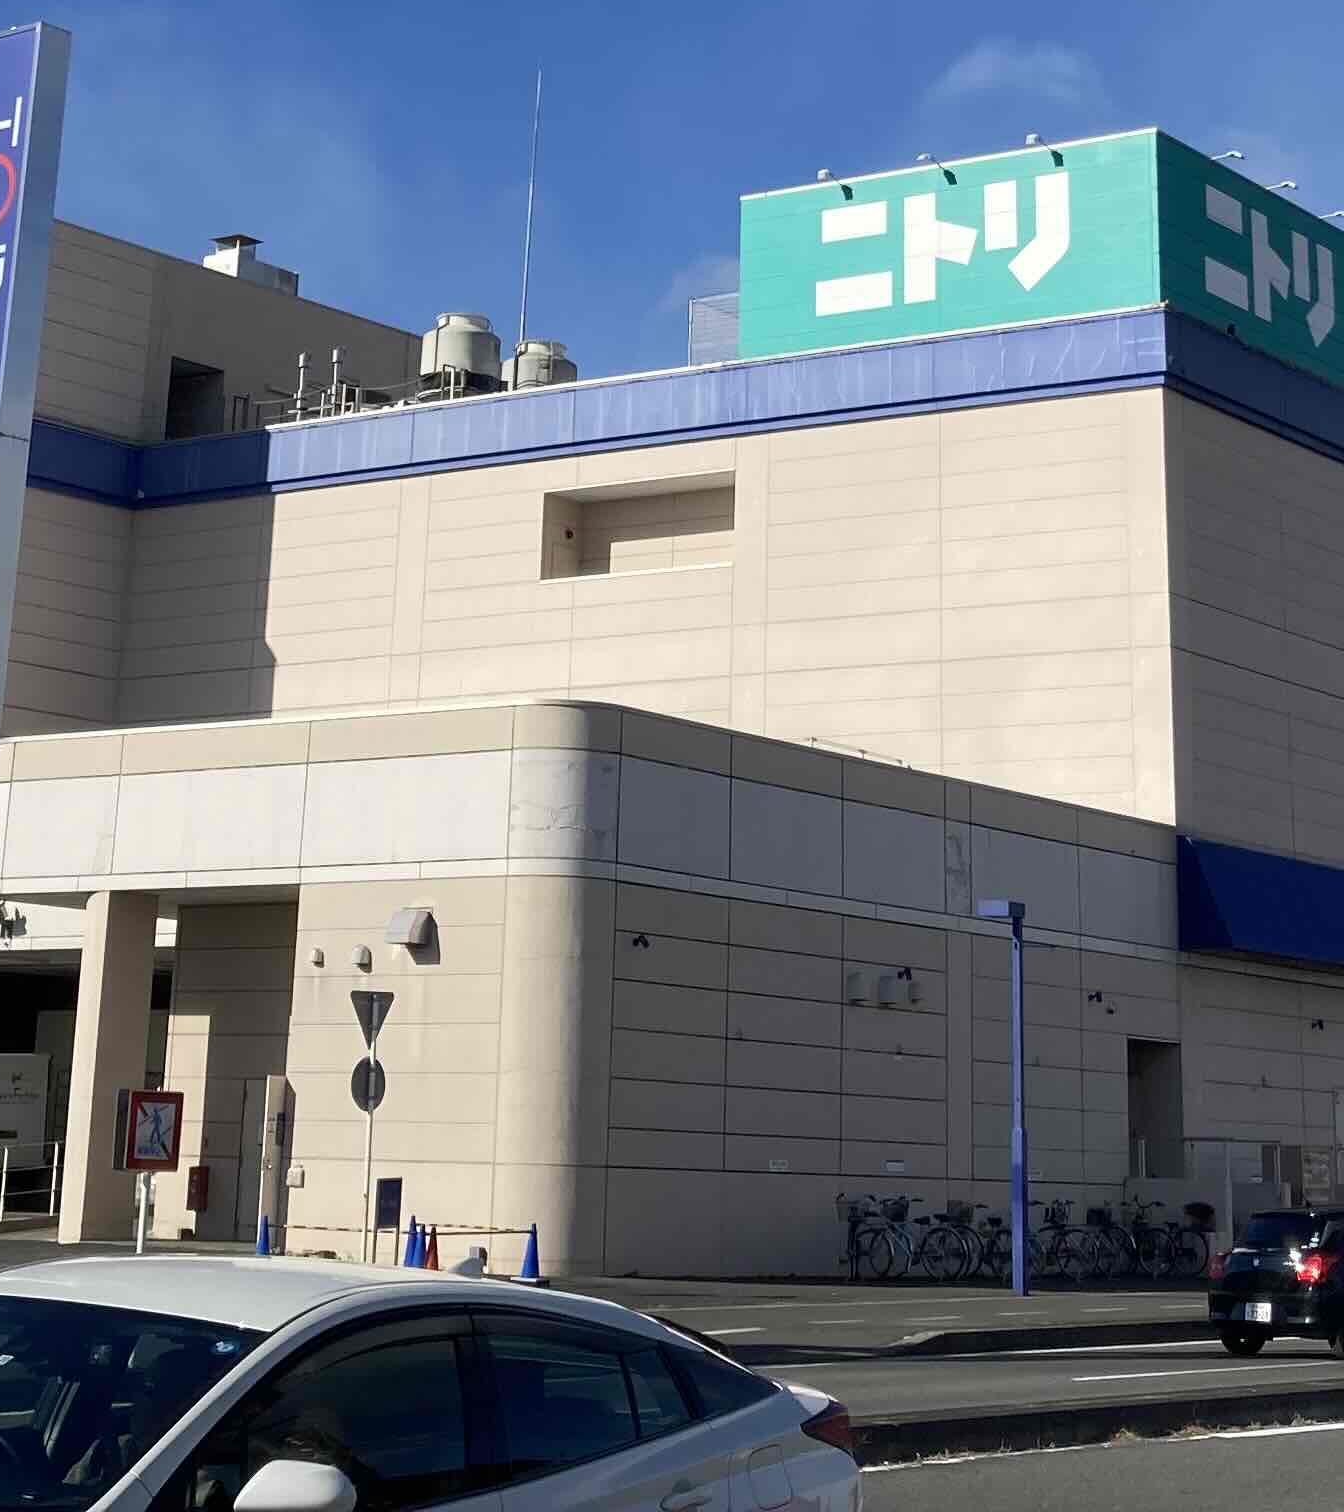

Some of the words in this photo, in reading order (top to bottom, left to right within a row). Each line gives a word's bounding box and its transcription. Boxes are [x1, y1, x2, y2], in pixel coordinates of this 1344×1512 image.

[815, 171, 1070, 317] ニトリ
[1204, 183, 1334, 347] ニトリ
